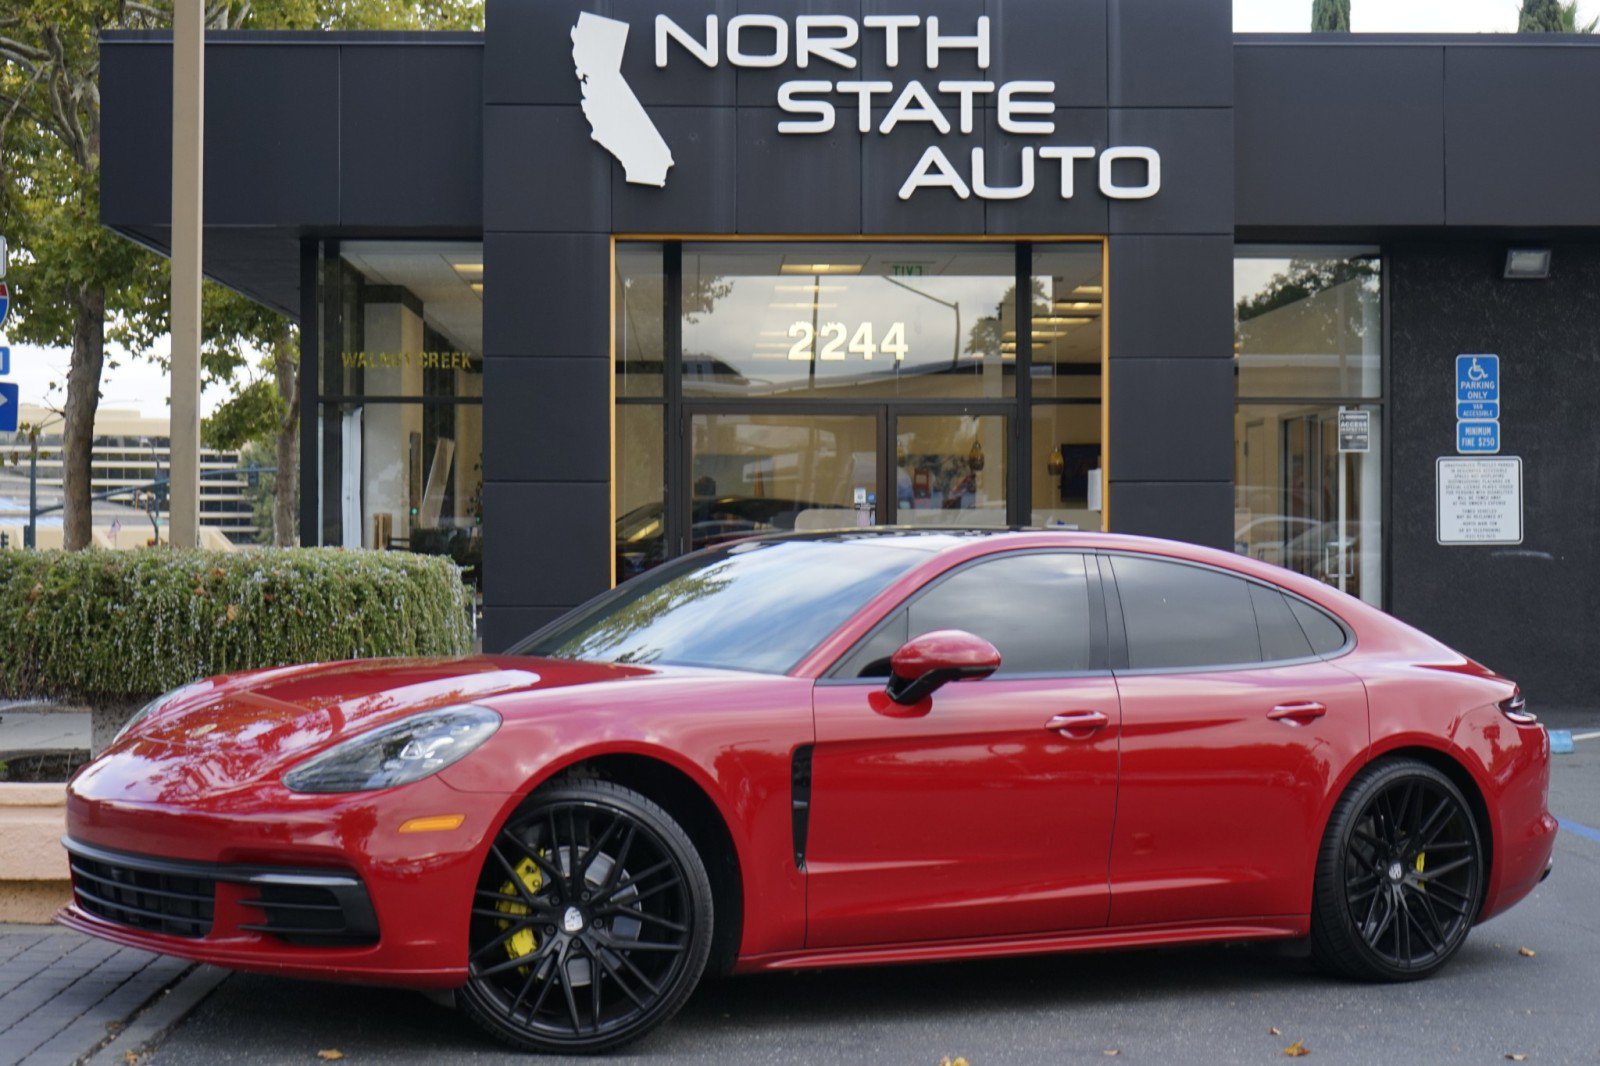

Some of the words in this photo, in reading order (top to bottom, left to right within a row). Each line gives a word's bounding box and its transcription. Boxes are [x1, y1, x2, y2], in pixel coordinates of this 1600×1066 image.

[654, 14, 990, 69] NORTH
[777, 79, 1056, 135] STATE
[898, 145, 1161, 200] AUTO
[787, 320, 909, 361] 2244
[419, 351, 472, 369] CREEK
[1461, 381, 1495, 389] PARKING
[1467, 391, 1488, 399] ONLY
[1465, 426, 1492, 436] MINIMUM
[1461, 437, 1475, 447] FINE
[1478, 437, 1496, 447] $250
